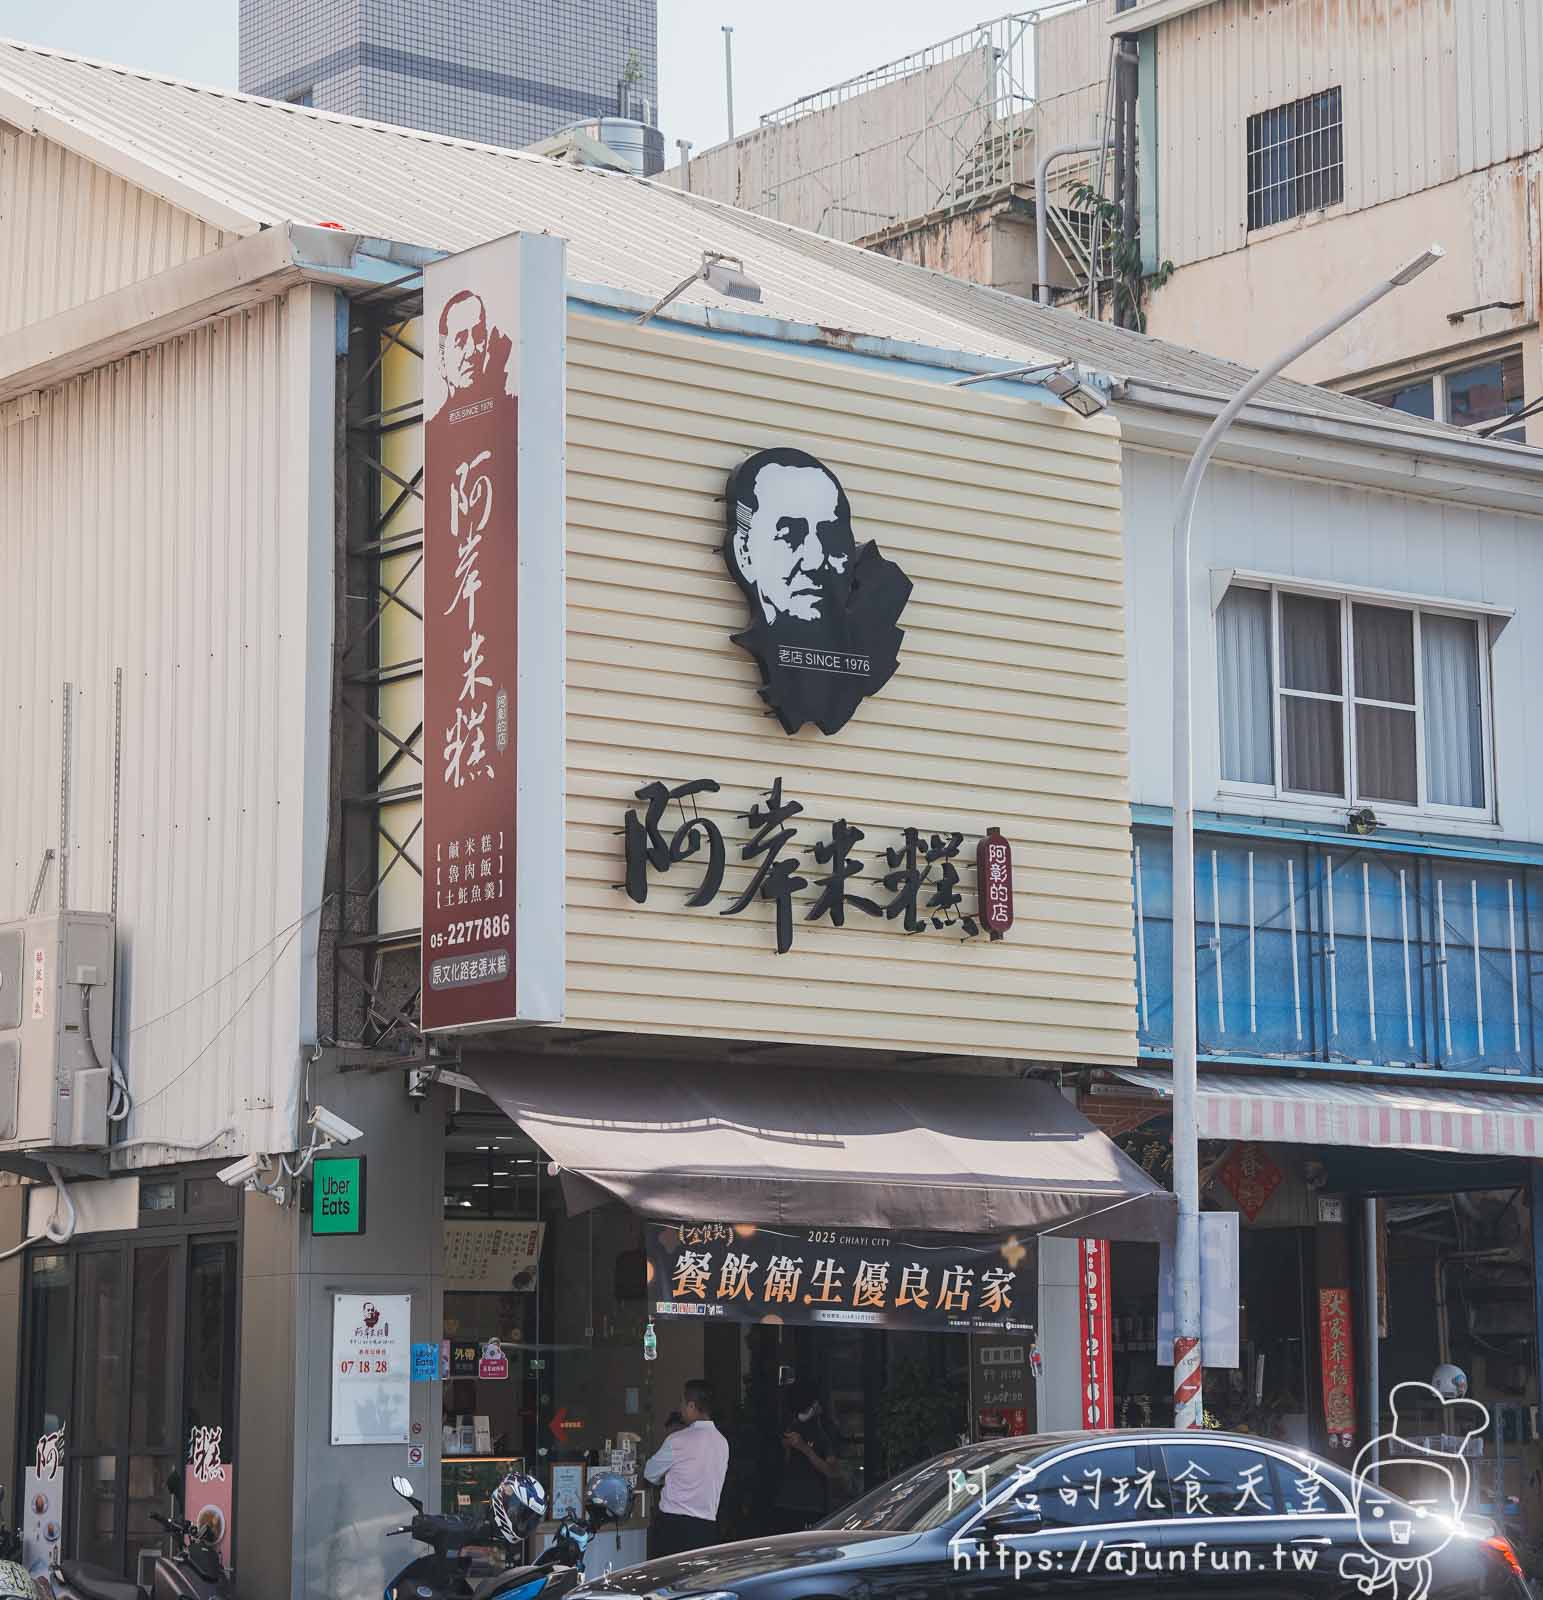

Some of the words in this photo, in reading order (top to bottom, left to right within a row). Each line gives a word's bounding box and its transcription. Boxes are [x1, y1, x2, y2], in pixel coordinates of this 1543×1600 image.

[443, 450, 495, 788] 阿岸米糕
[778, 649, 803, 665] 老店
[805, 653, 841, 669] SINCE
[845, 658, 871, 672] 1976
[624, 776, 980, 954] 阿岸米糕
[989, 844, 1008, 922] 阿彰的店
[430, 914, 510, 948] 05-2277886
[322, 1176, 351, 1195] Uber
[322, 1197, 350, 1215] Eats
[808, 1230, 836, 1244] 2025
[839, 1238, 868, 1247] CHIAYI
[871, 1238, 891, 1248] CITY
[671, 1251, 1016, 1313] 餐飲衛生優良店家
[341, 1360, 354, 1374] 07
[359, 1360, 370, 1373] 18
[375, 1360, 388, 1373] 28
